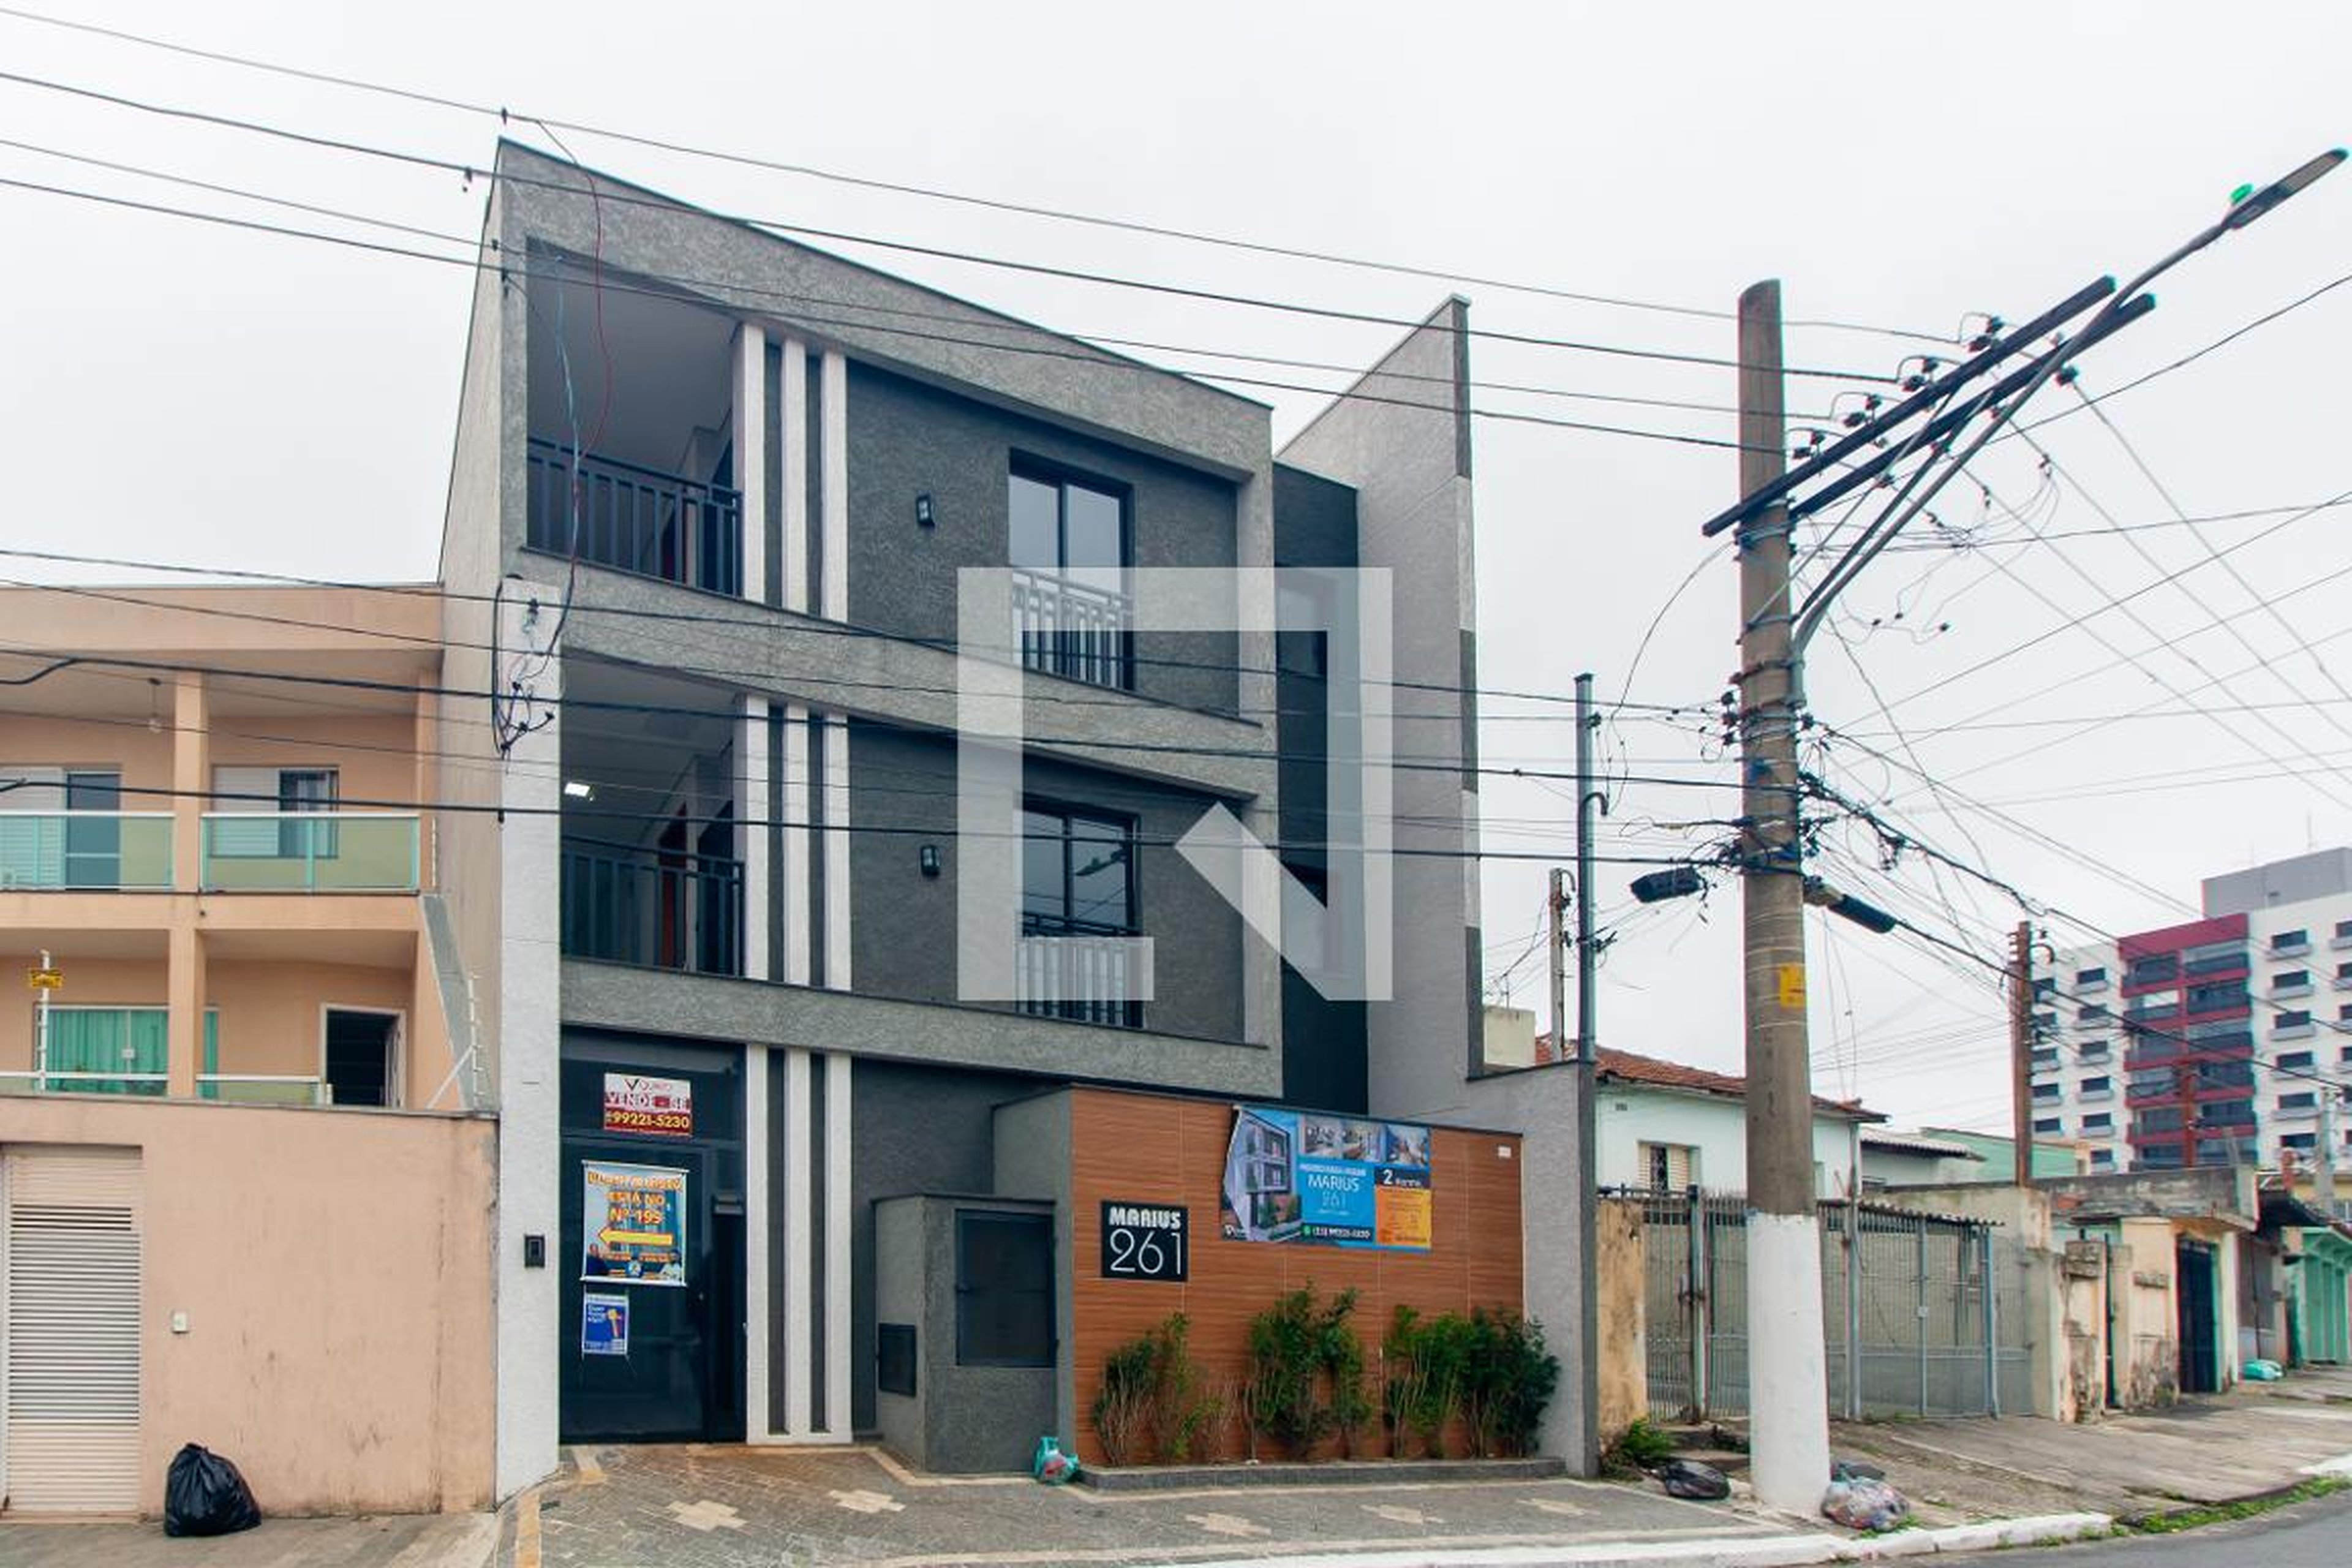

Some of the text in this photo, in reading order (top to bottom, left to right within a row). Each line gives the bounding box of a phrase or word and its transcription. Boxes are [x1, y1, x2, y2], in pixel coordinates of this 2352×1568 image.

[612, 1110, 690, 1128] 99221-5230
[1308, 1173, 1359, 1193] MARIUS
[1384, 1169, 1393, 1185] 2
[1109, 1206, 1181, 1231] MARIUS
[1110, 1228, 1182, 1275] 261
